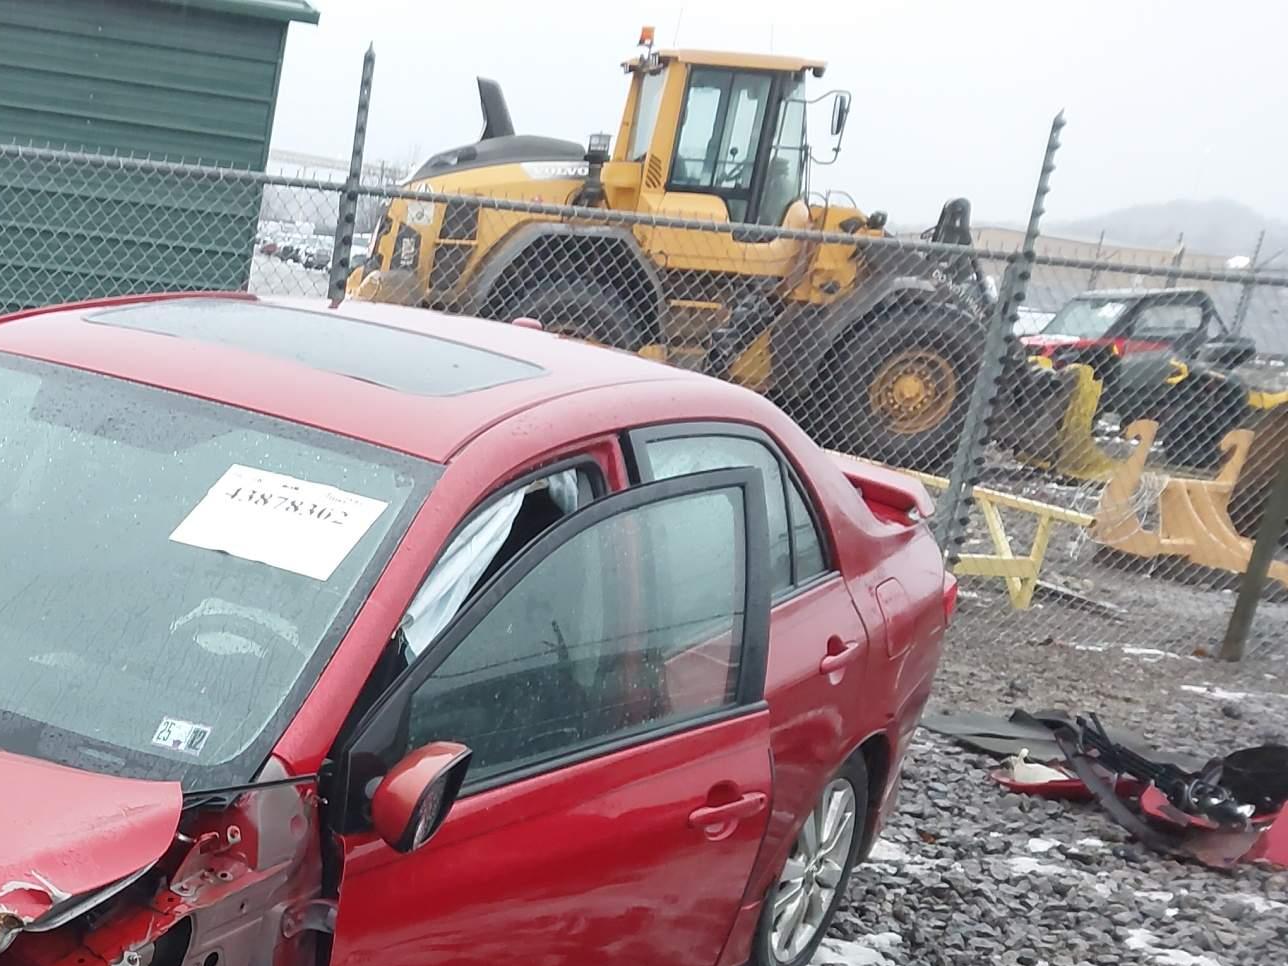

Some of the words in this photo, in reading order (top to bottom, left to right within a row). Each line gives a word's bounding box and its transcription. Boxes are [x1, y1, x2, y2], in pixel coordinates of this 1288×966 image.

[536, 166, 589, 176] VOLVO
[225, 487, 349, 525] 43878302
[157, 721, 176, 742] 25
[186, 727, 208, 751] 12
